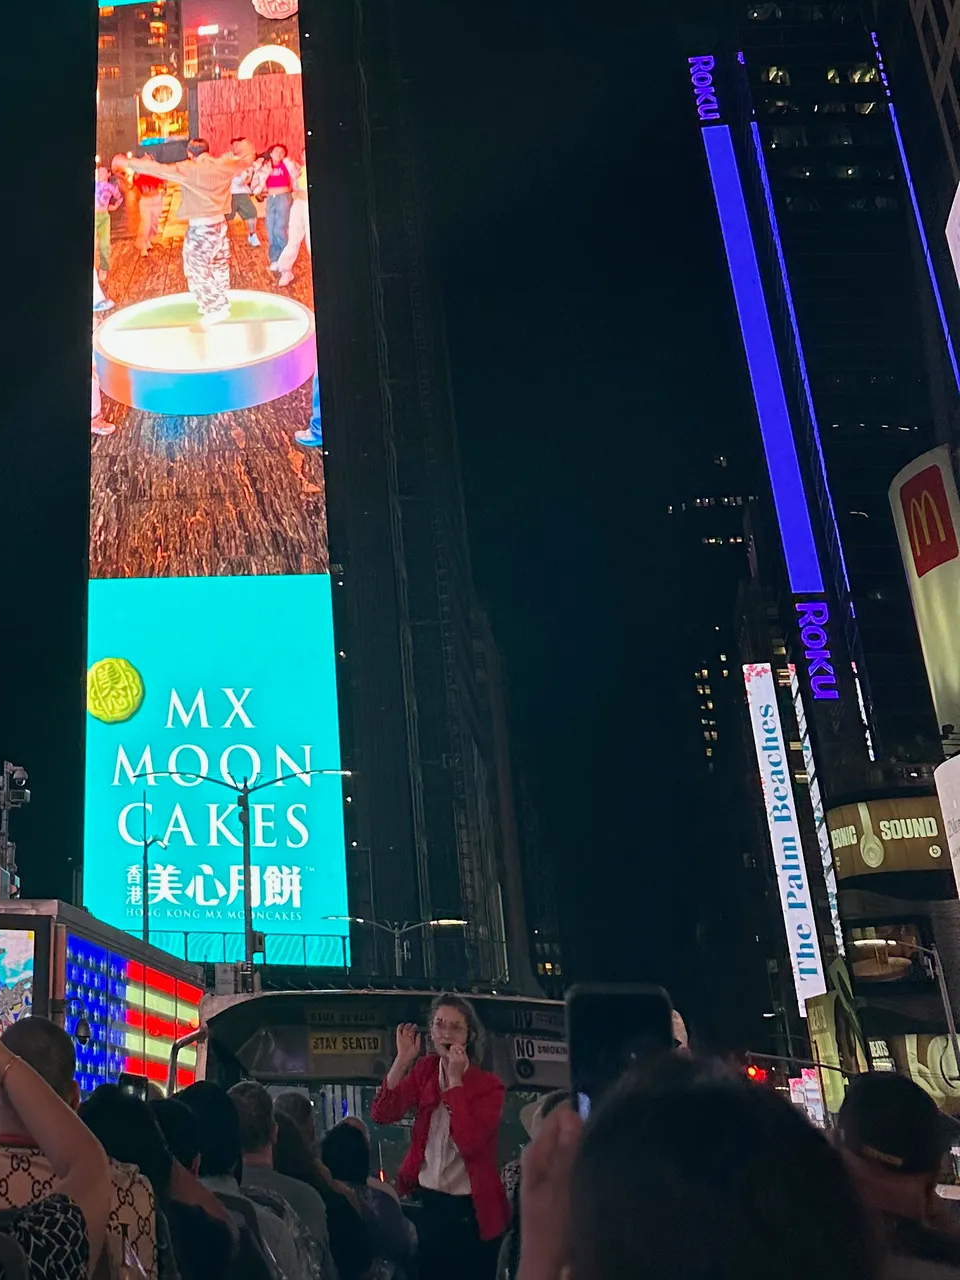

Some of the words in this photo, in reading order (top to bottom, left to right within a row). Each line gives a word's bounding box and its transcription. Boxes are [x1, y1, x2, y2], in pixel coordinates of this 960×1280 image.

[164, 687, 257, 729] MX
[111, 743, 313, 788] MOON
[759, 703, 793, 822] Beaches
[117, 802, 309, 849] CAKES
[880, 817, 939, 840] SOUND
[125, 863, 143, 905] 香港
[147, 864, 302, 908] 美心月餅
[782, 836, 808, 910] Palm
[126, 907, 161, 918] HOG
[166, 908, 200, 918] KONG
[205, 910, 223, 919] MX
[796, 922, 818, 980] The
[312, 1036, 338, 1050] STAY
[341, 1036, 379, 1050] SEATED
[515, 1038, 535, 1059] NO
[537, 1044, 568, 1055] SMOKIN
[868, 1040, 889, 1058] BEATS
